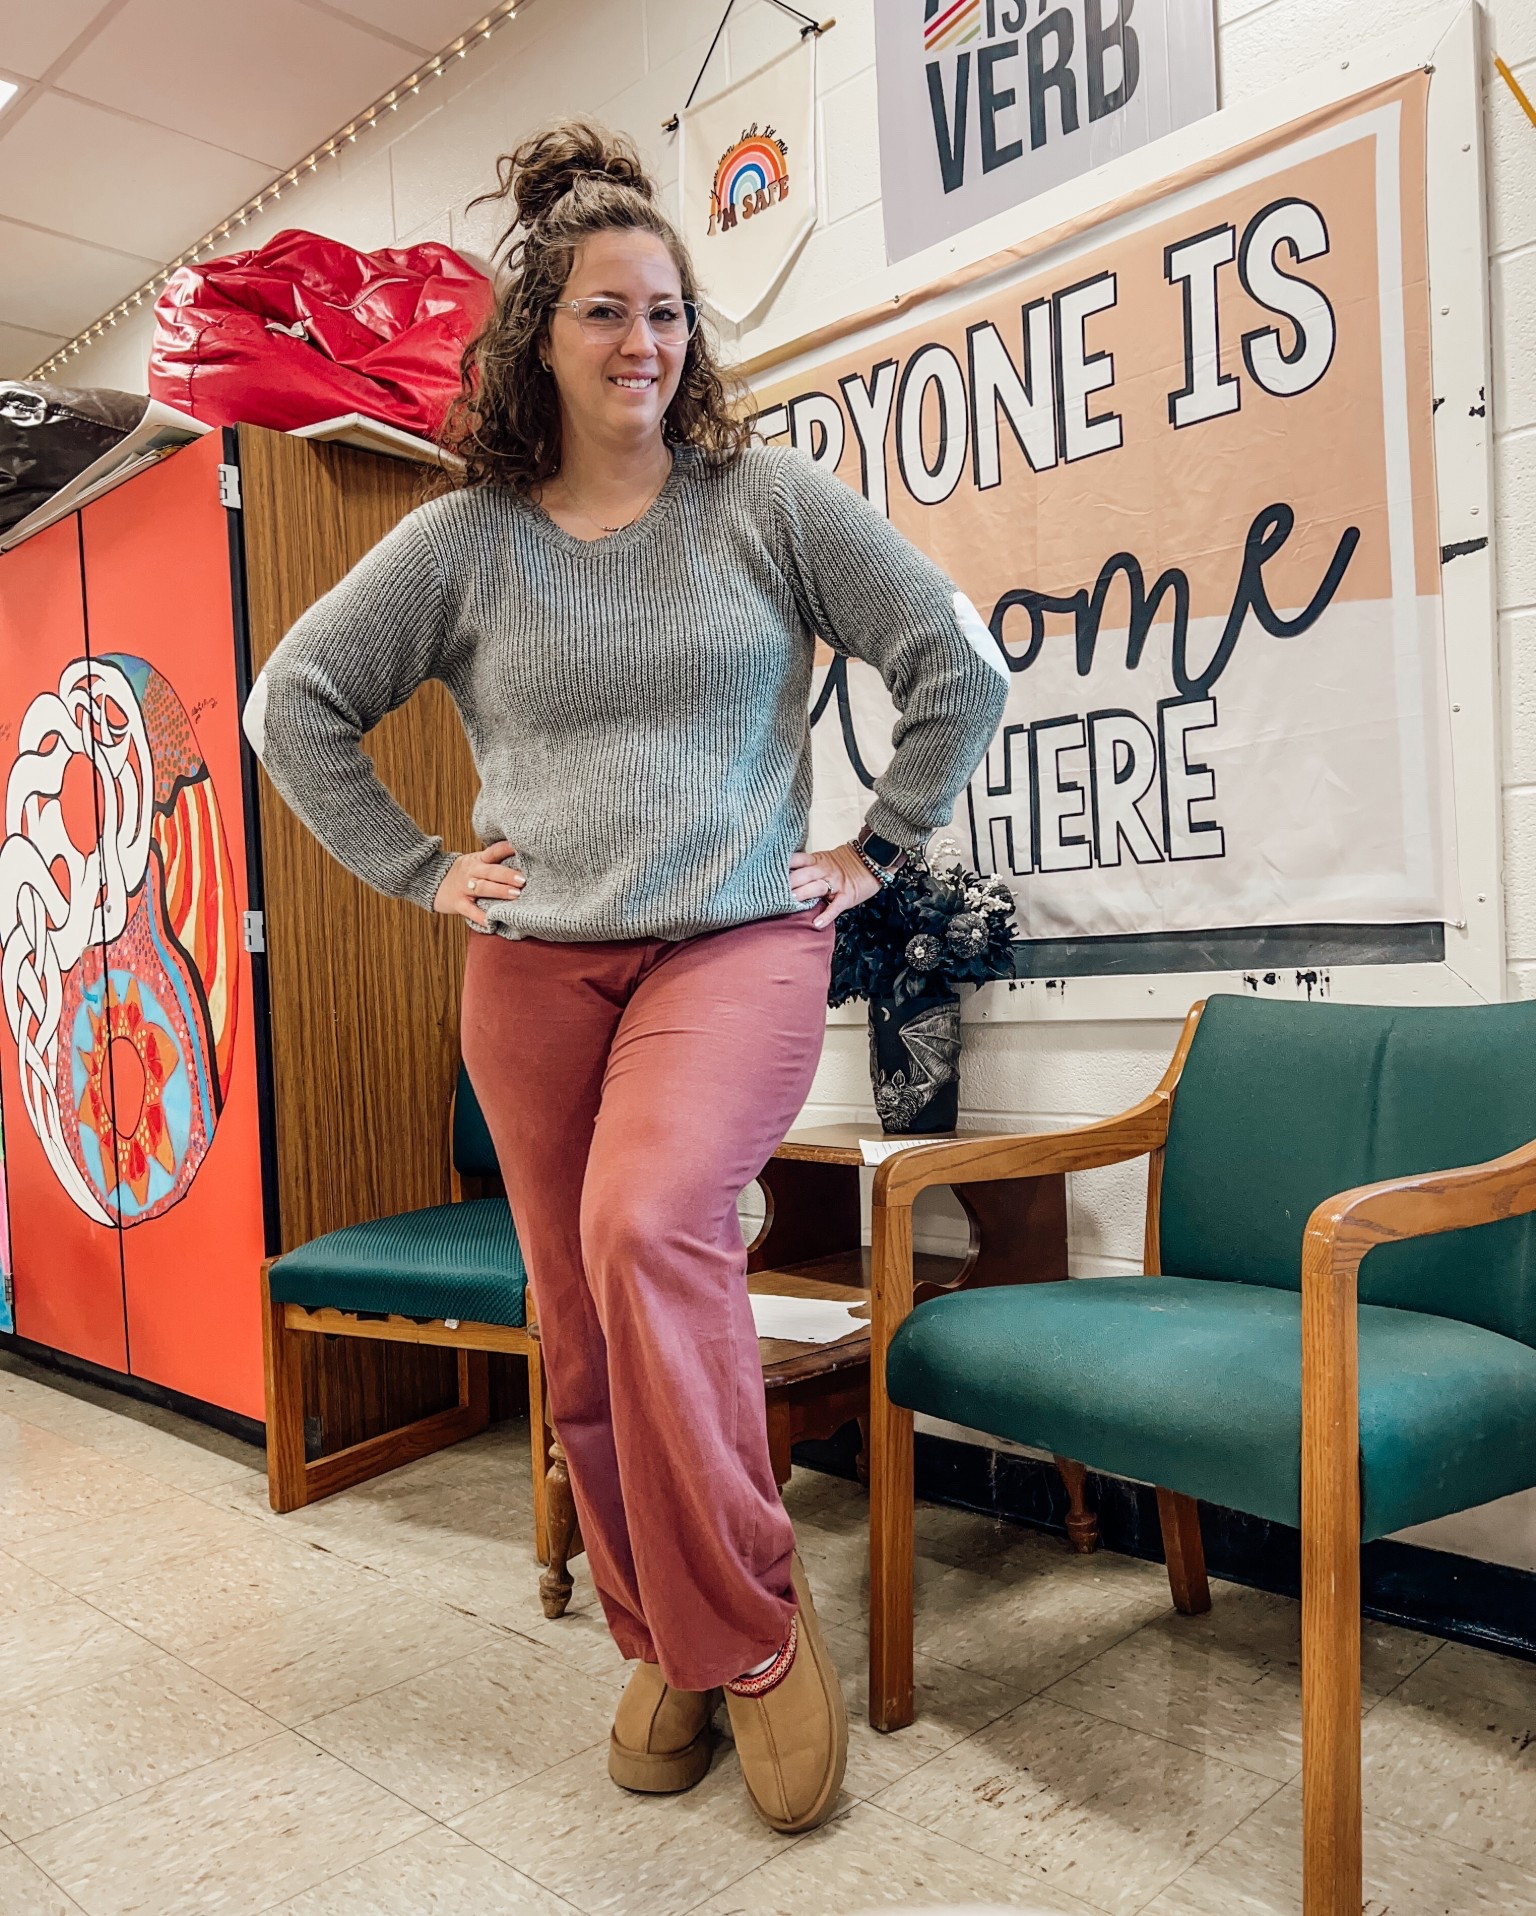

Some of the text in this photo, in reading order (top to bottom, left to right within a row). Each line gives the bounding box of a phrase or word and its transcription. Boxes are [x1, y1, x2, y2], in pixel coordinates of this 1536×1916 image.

[717, 144, 735, 166] can
[737, 121, 759, 146] talk
[760, 124, 777, 139] to
[773, 138, 789, 156] me
[925, 0, 1140, 194] VERB
[706, 174, 790, 236] I'M SAFE
[1164, 197, 1337, 430] IS
[967, 696, 1226, 879] HERE
